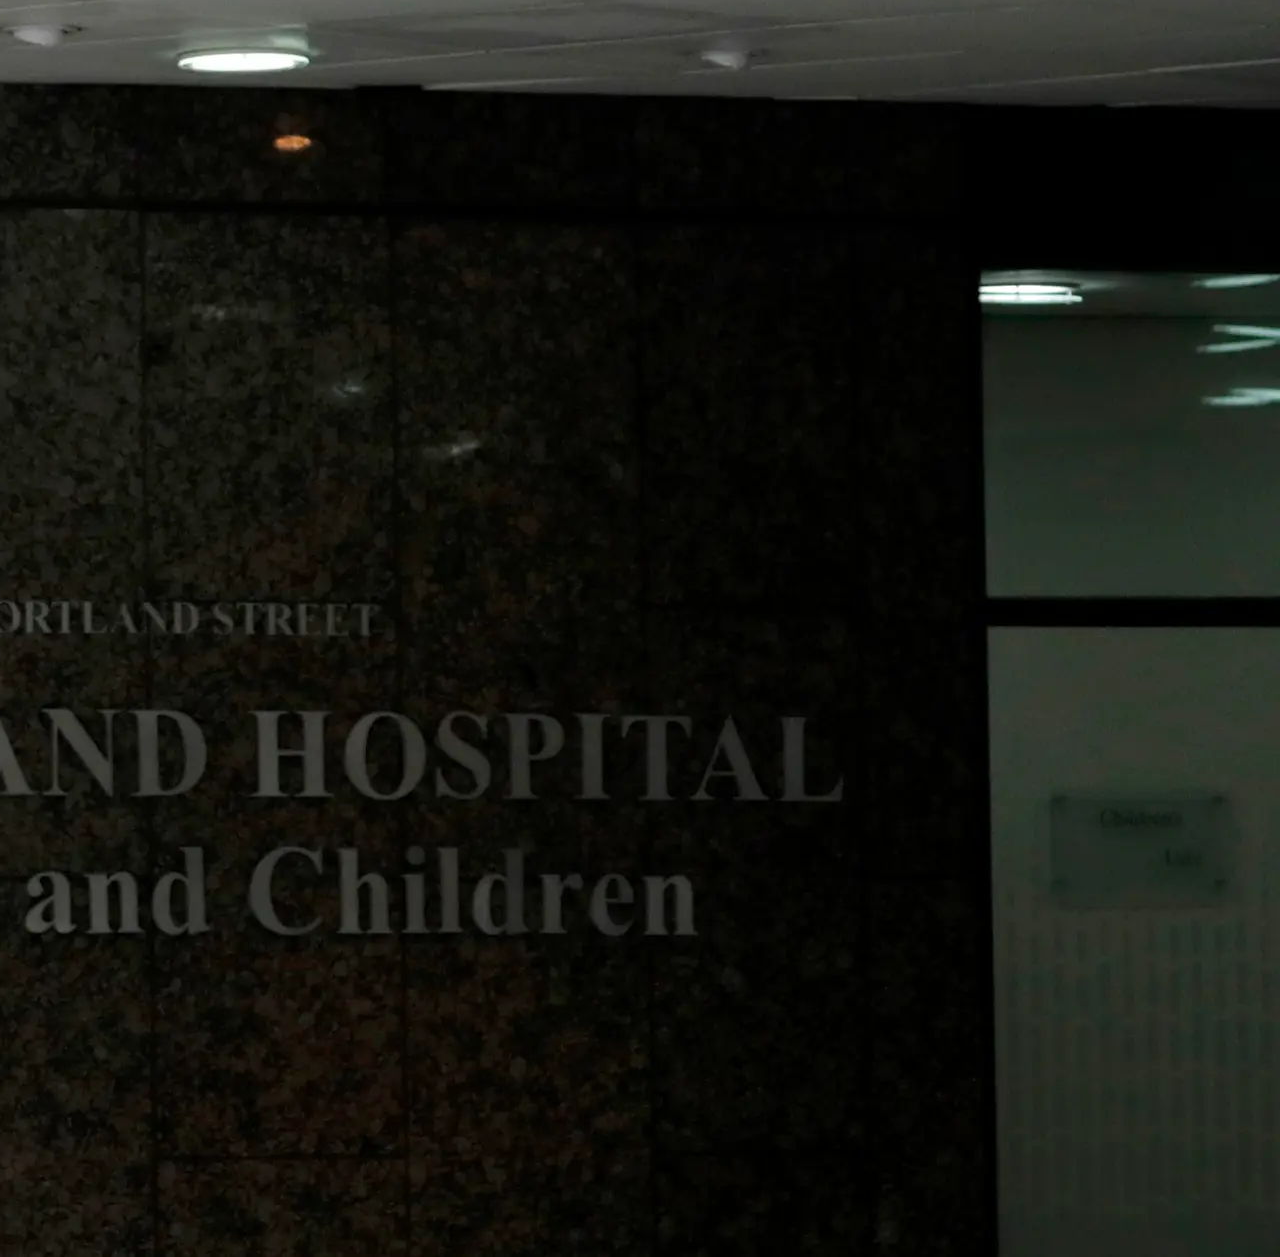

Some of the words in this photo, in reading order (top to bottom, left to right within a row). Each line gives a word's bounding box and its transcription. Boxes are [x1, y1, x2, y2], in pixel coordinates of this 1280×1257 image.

[212, 600, 384, 638] STREET
[248, 708, 844, 804] HOSPITAL
[23, 845, 212, 938] and
[246, 845, 699, 938] Children
